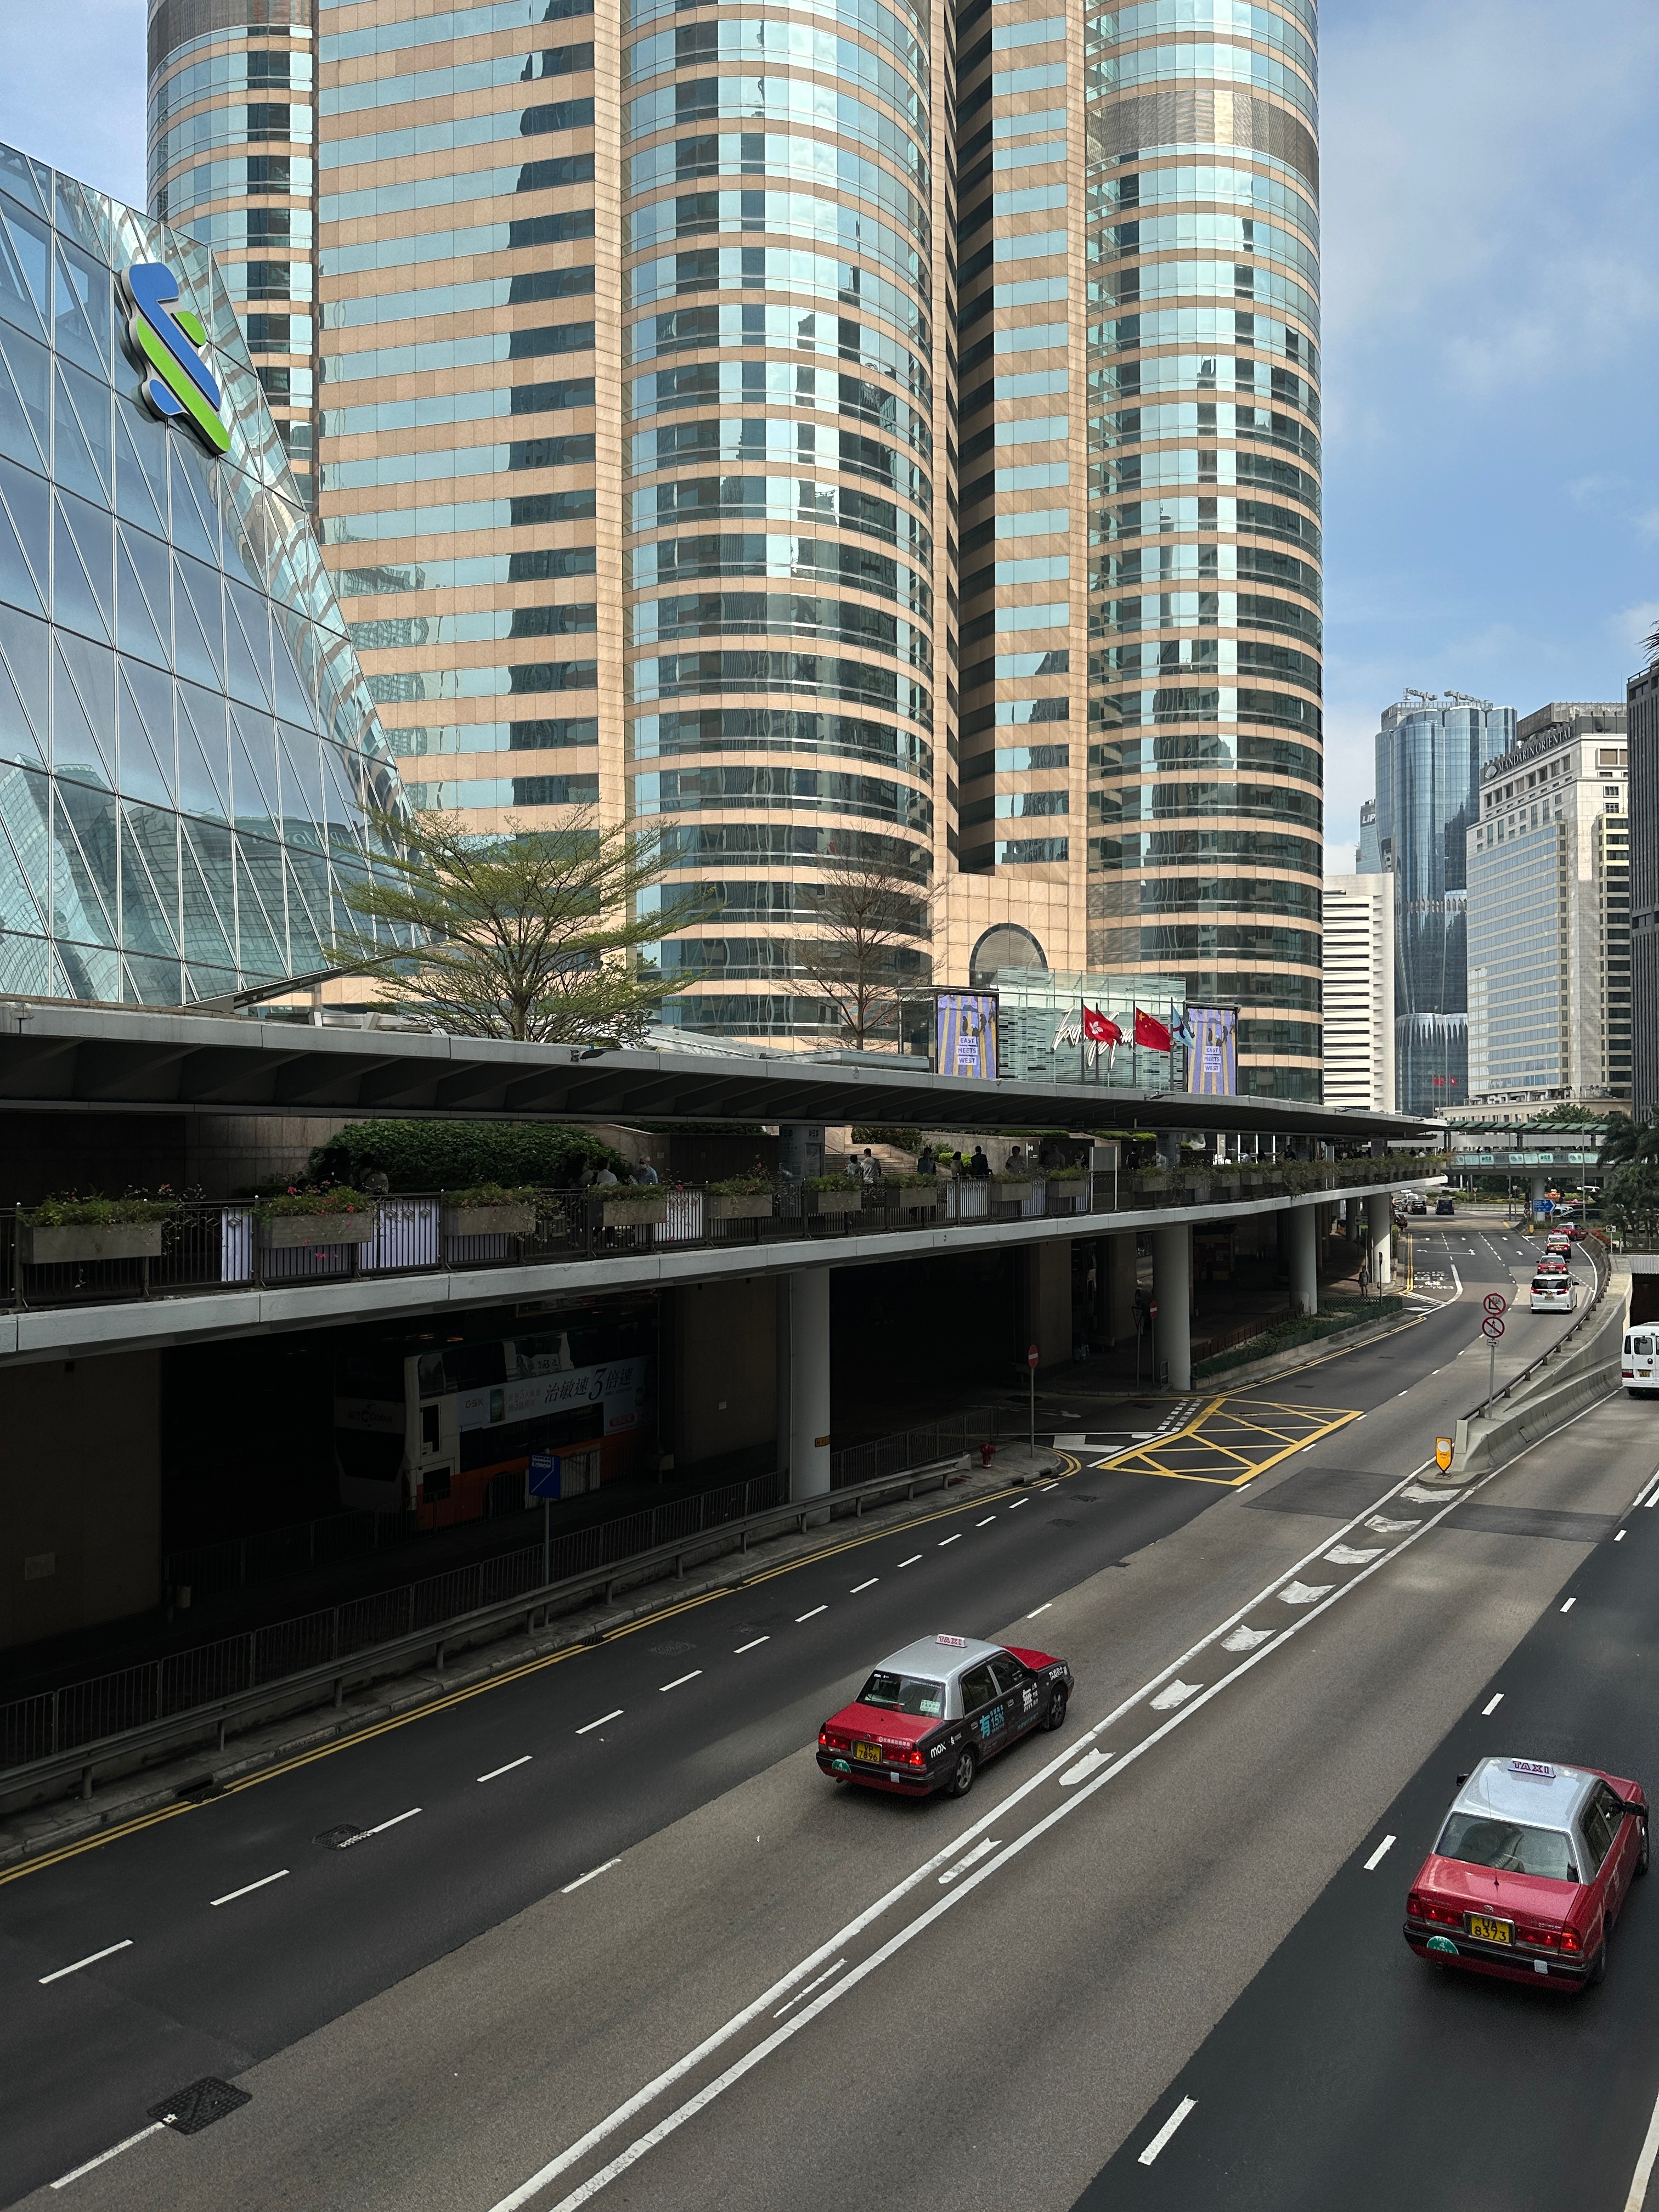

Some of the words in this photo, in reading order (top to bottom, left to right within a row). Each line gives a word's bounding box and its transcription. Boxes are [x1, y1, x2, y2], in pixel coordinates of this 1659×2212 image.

[1498, 746, 1535, 772] MANDARIN
[1536, 726, 1572, 754] ORIENTAL
[465, 1395, 483, 1408] GSK
[370, 1412, 392, 1423] Citybus
[938, 1635, 962, 1646] TAXI
[1022, 1688, 1033, 1713] 無
[979, 1714, 990, 1739] 有
[991, 1711, 1005, 1728] 15%
[864, 1743, 874, 1753] VP
[930, 1743, 946, 1759] mox
[858, 1750, 878, 1762] 7896
[1512, 1760, 1550, 1774] TAXI
[1481, 1918, 1498, 1932] UA
[1474, 1925, 1507, 1942] 8373
